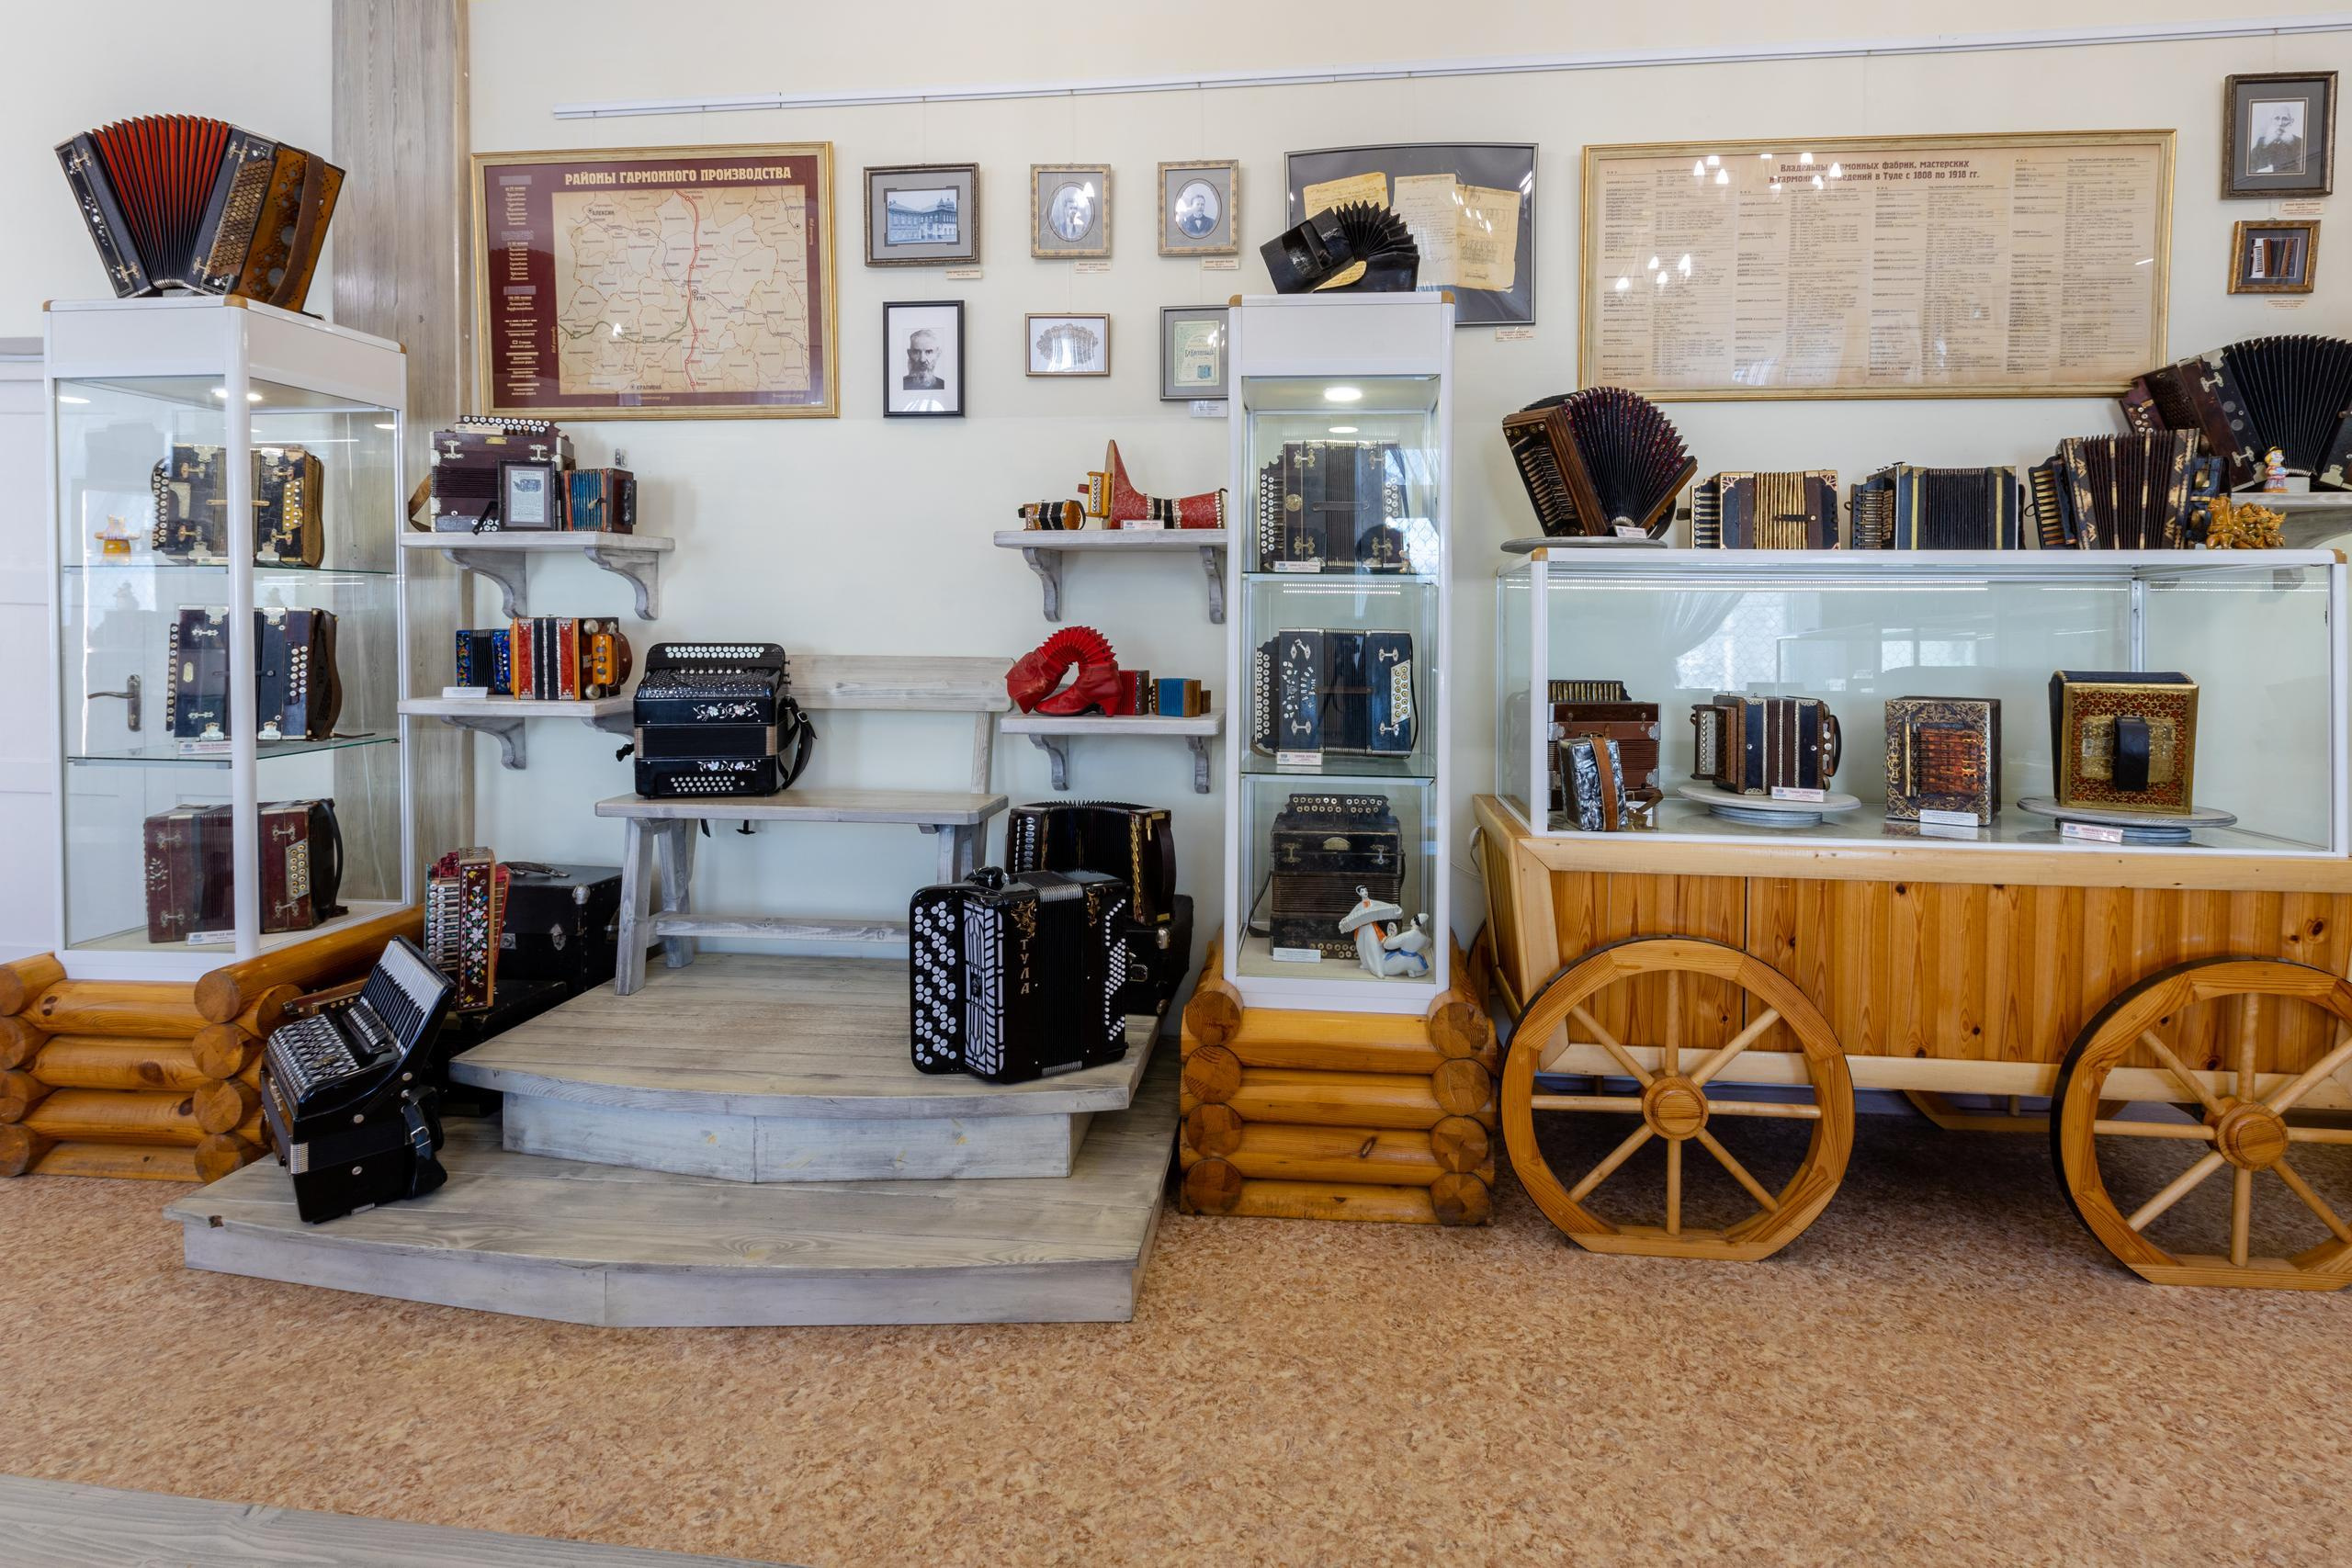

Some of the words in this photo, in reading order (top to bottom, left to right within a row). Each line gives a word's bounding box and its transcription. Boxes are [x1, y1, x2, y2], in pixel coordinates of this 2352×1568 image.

[1781, 164, 1828, 172] Владельцы
[1882, 161, 1917, 170] фабрик,
[1919, 160, 1970, 169] мастерских
[565, 173, 616, 186] РАЙОНЫ
[619, 170, 696, 184] ГАРМОННОГО
[700, 166, 792, 181] ПРОИЗВОДСТВА
[1883, 172, 1903, 181] Туле
[1914, 171, 1932, 179] 1808
[1935, 171, 1945, 179] по
[1949, 170, 1966, 178] 1918
[1020, 939, 1030, 995] ТУЛА
